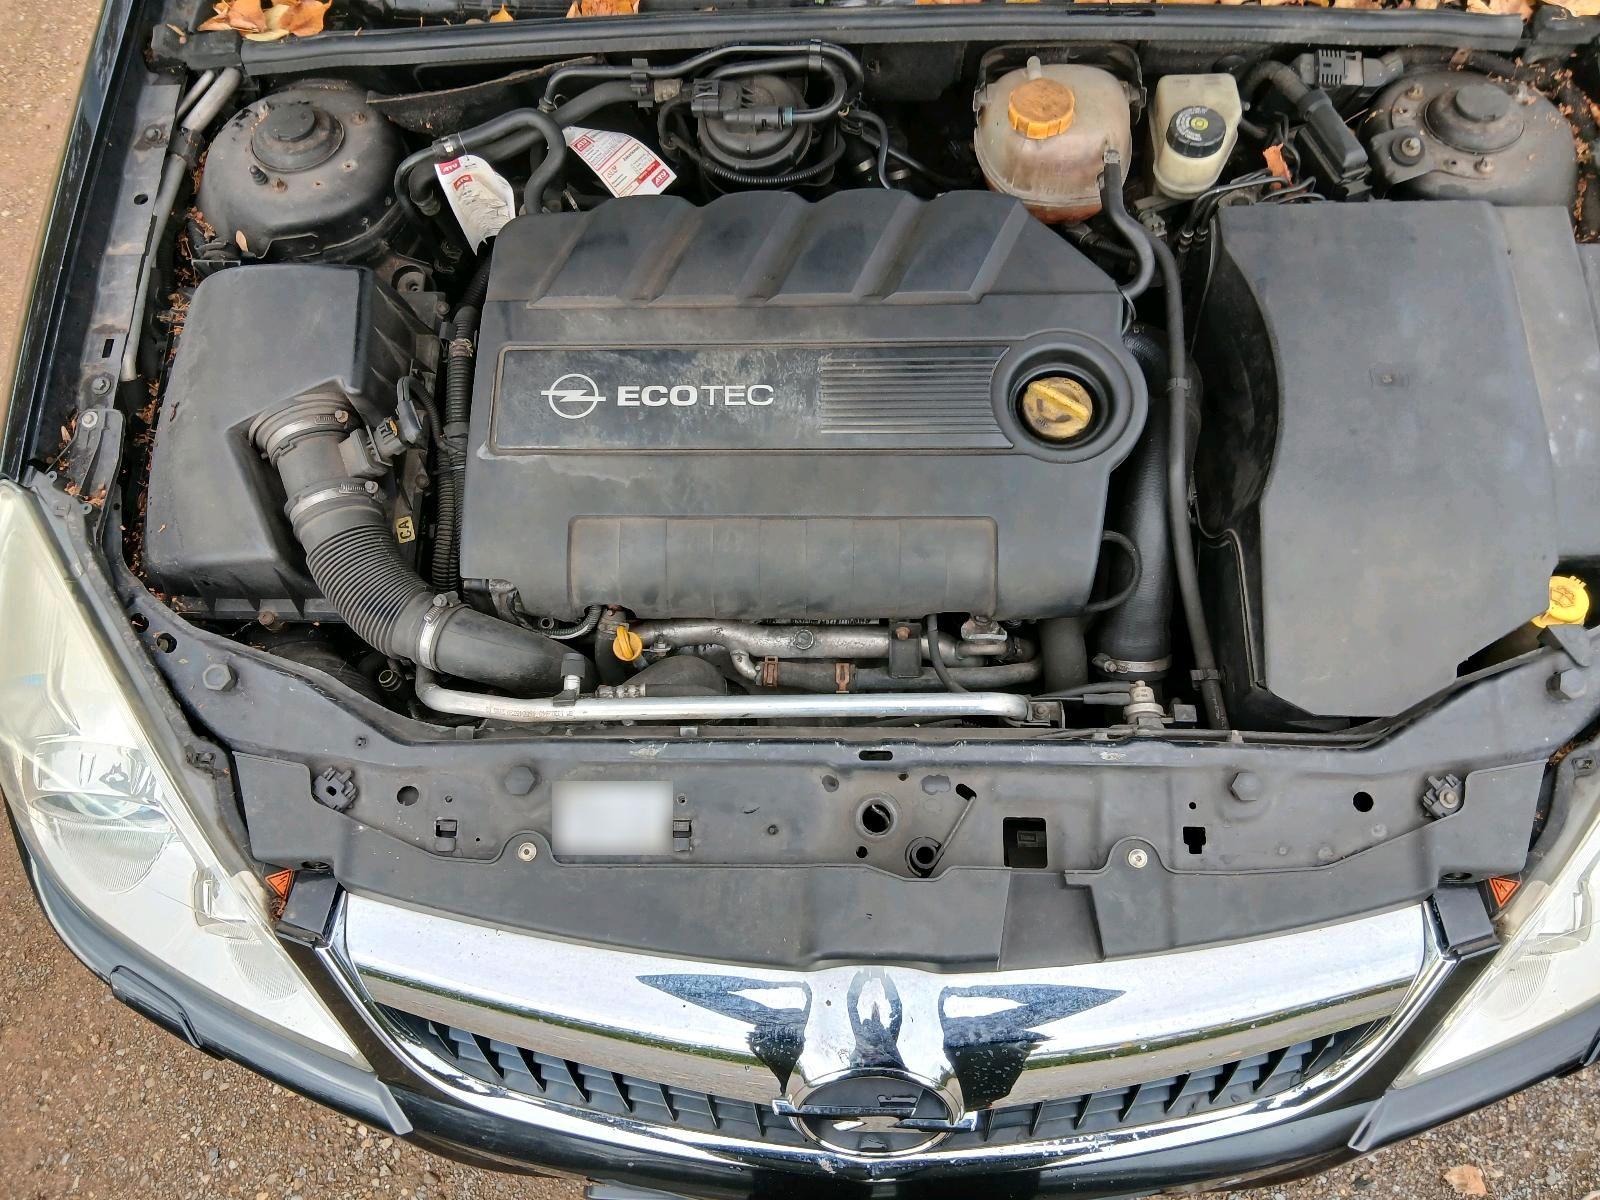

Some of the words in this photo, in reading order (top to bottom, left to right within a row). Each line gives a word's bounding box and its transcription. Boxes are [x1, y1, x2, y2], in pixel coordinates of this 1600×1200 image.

[442, 163, 458, 172] ATU
[655, 171, 668, 187] ATU
[617, 385, 774, 406] ECOTEC
[398, 519, 412, 539] CA
